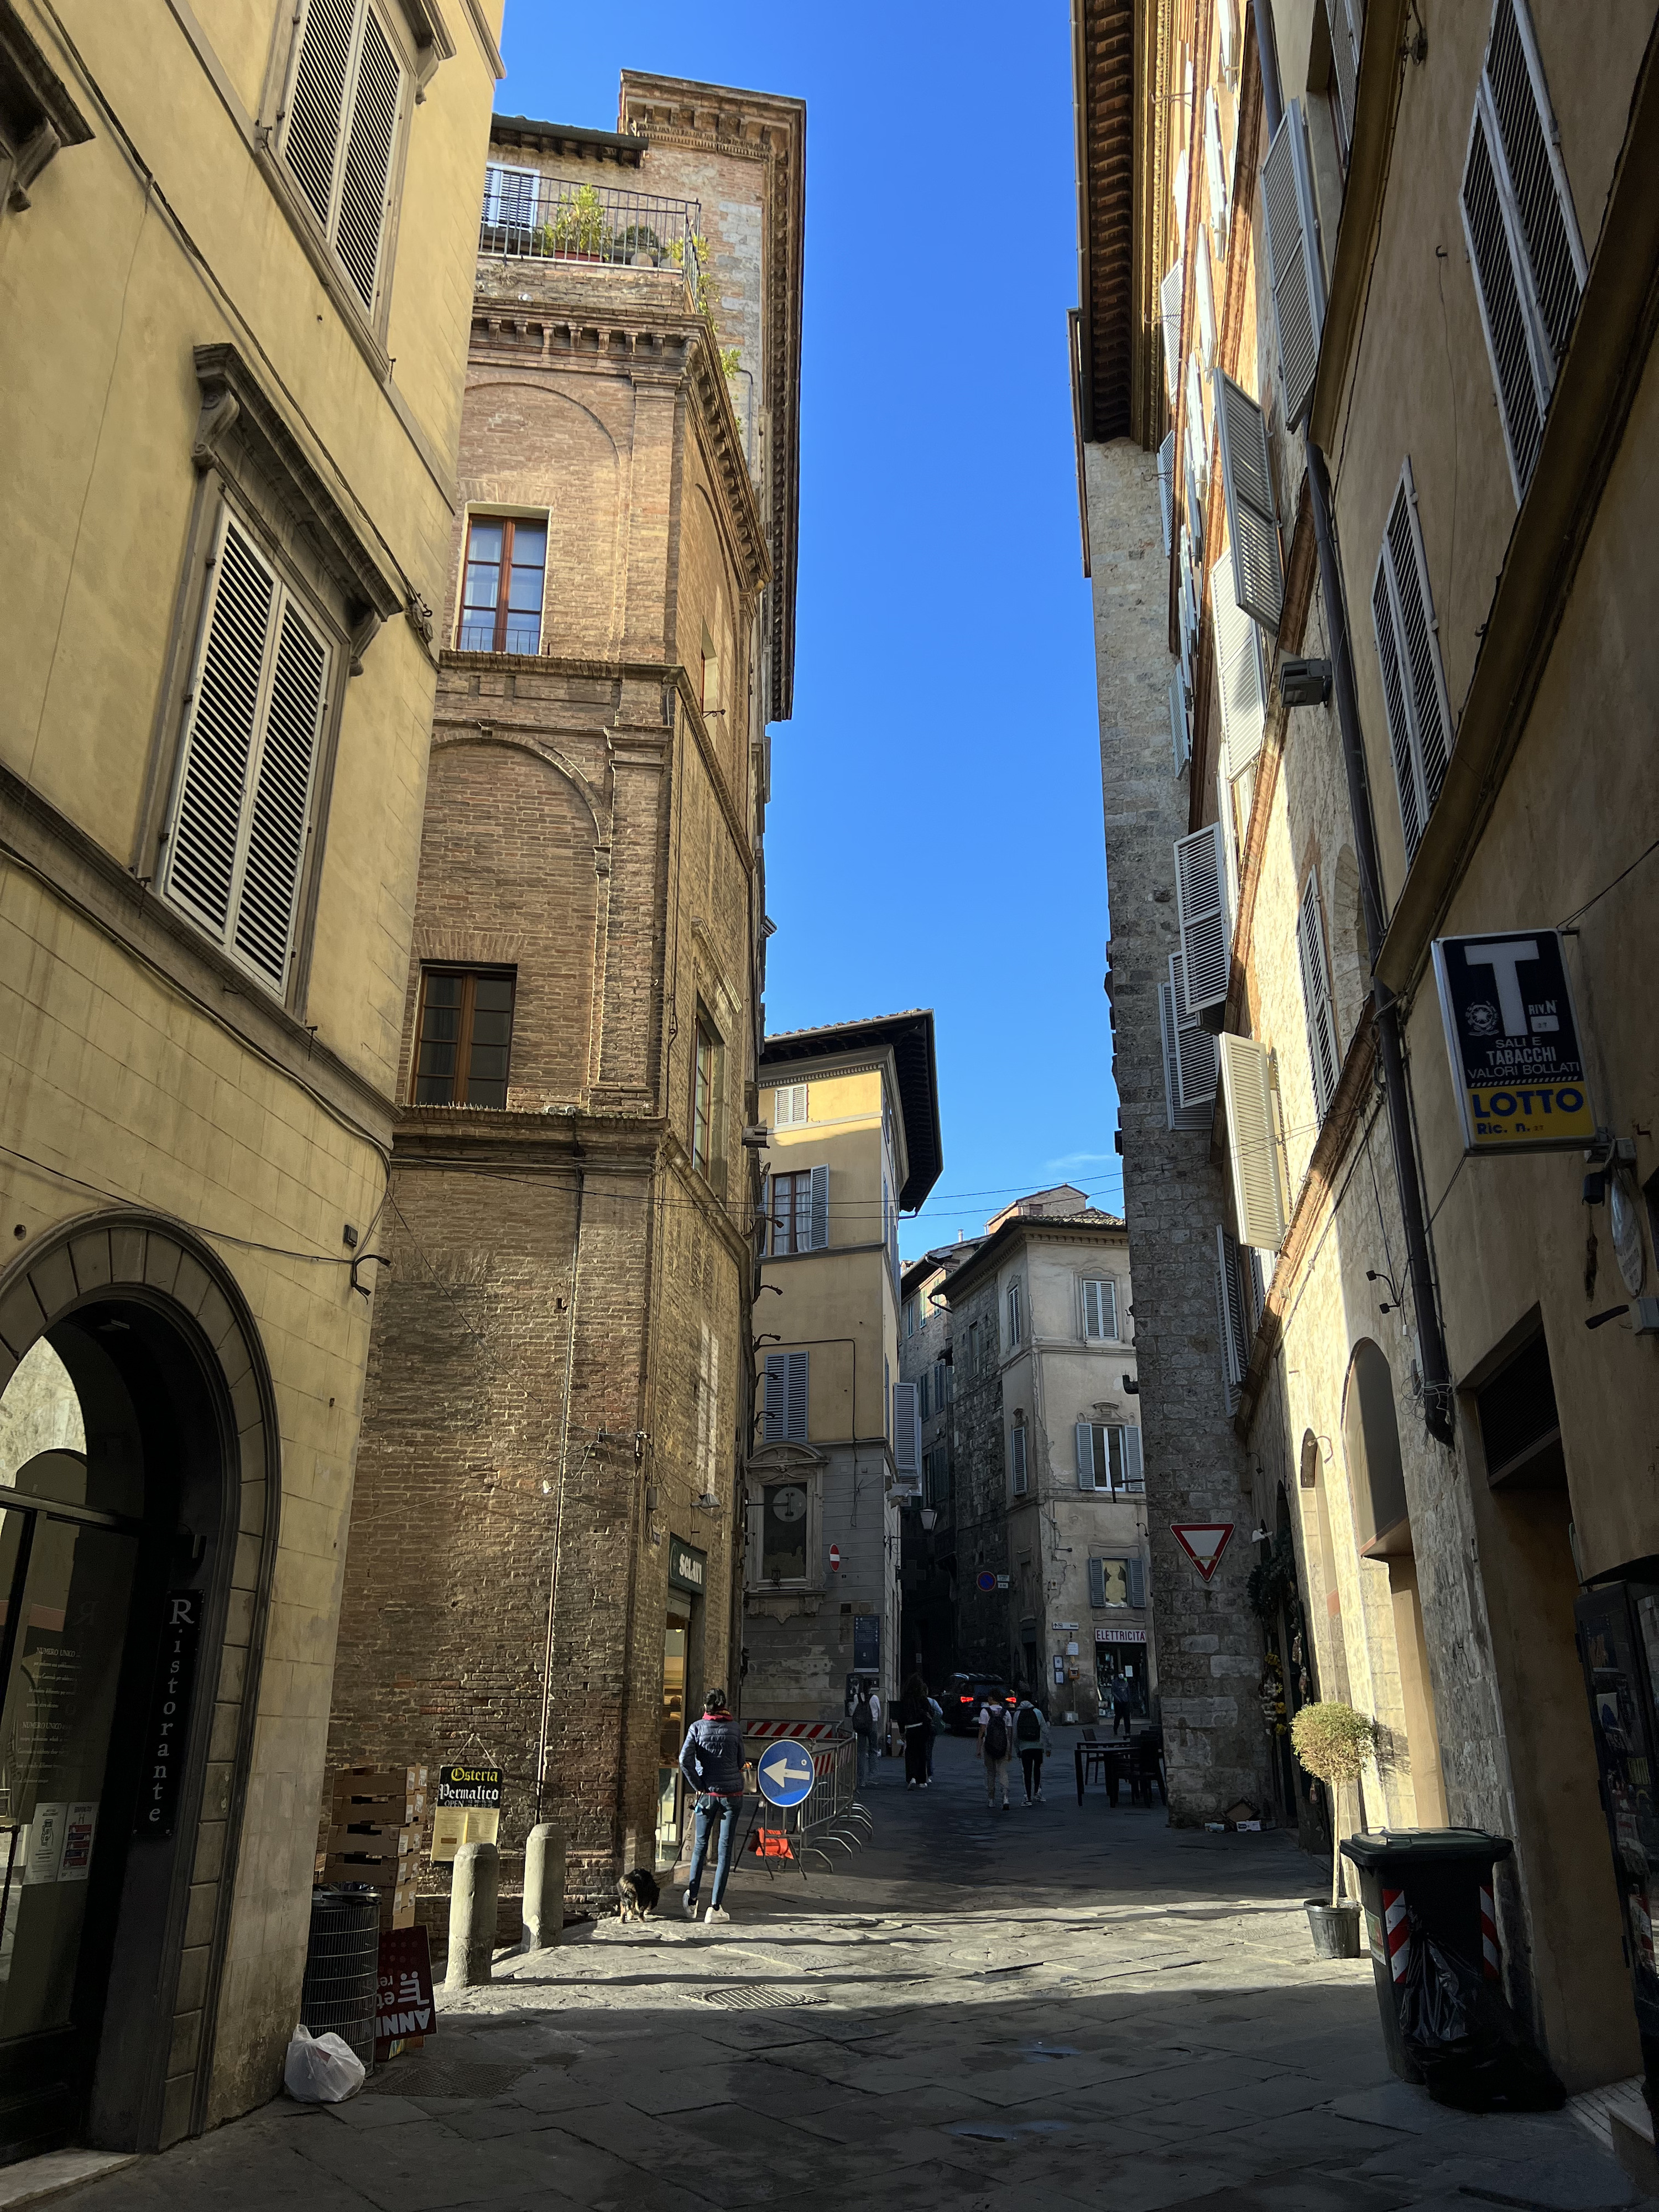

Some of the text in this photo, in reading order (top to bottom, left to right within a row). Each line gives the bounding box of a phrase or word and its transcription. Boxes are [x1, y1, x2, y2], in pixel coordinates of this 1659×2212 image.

[1464, 940, 1540, 1037] T
[1495, 1036, 1542, 1048] SALI E
[1486, 1046, 1557, 1066] TABACCHI
[1467, 1062, 1580, 1079] VALORI BOLLATI
[1472, 1088, 1584, 1118] LOTTO
[1477, 1122, 1508, 1135] Ric.
[1515, 1123, 1530, 1133] n.
[679, 1553, 702, 1585] SCLAVI
[36, 1647, 76, 1658] NUMERO UNICO
[45, 1721, 62, 1730] UNICO
[451, 1767, 498, 1782] Osteria
[439, 1784, 499, 1801] Permalico
